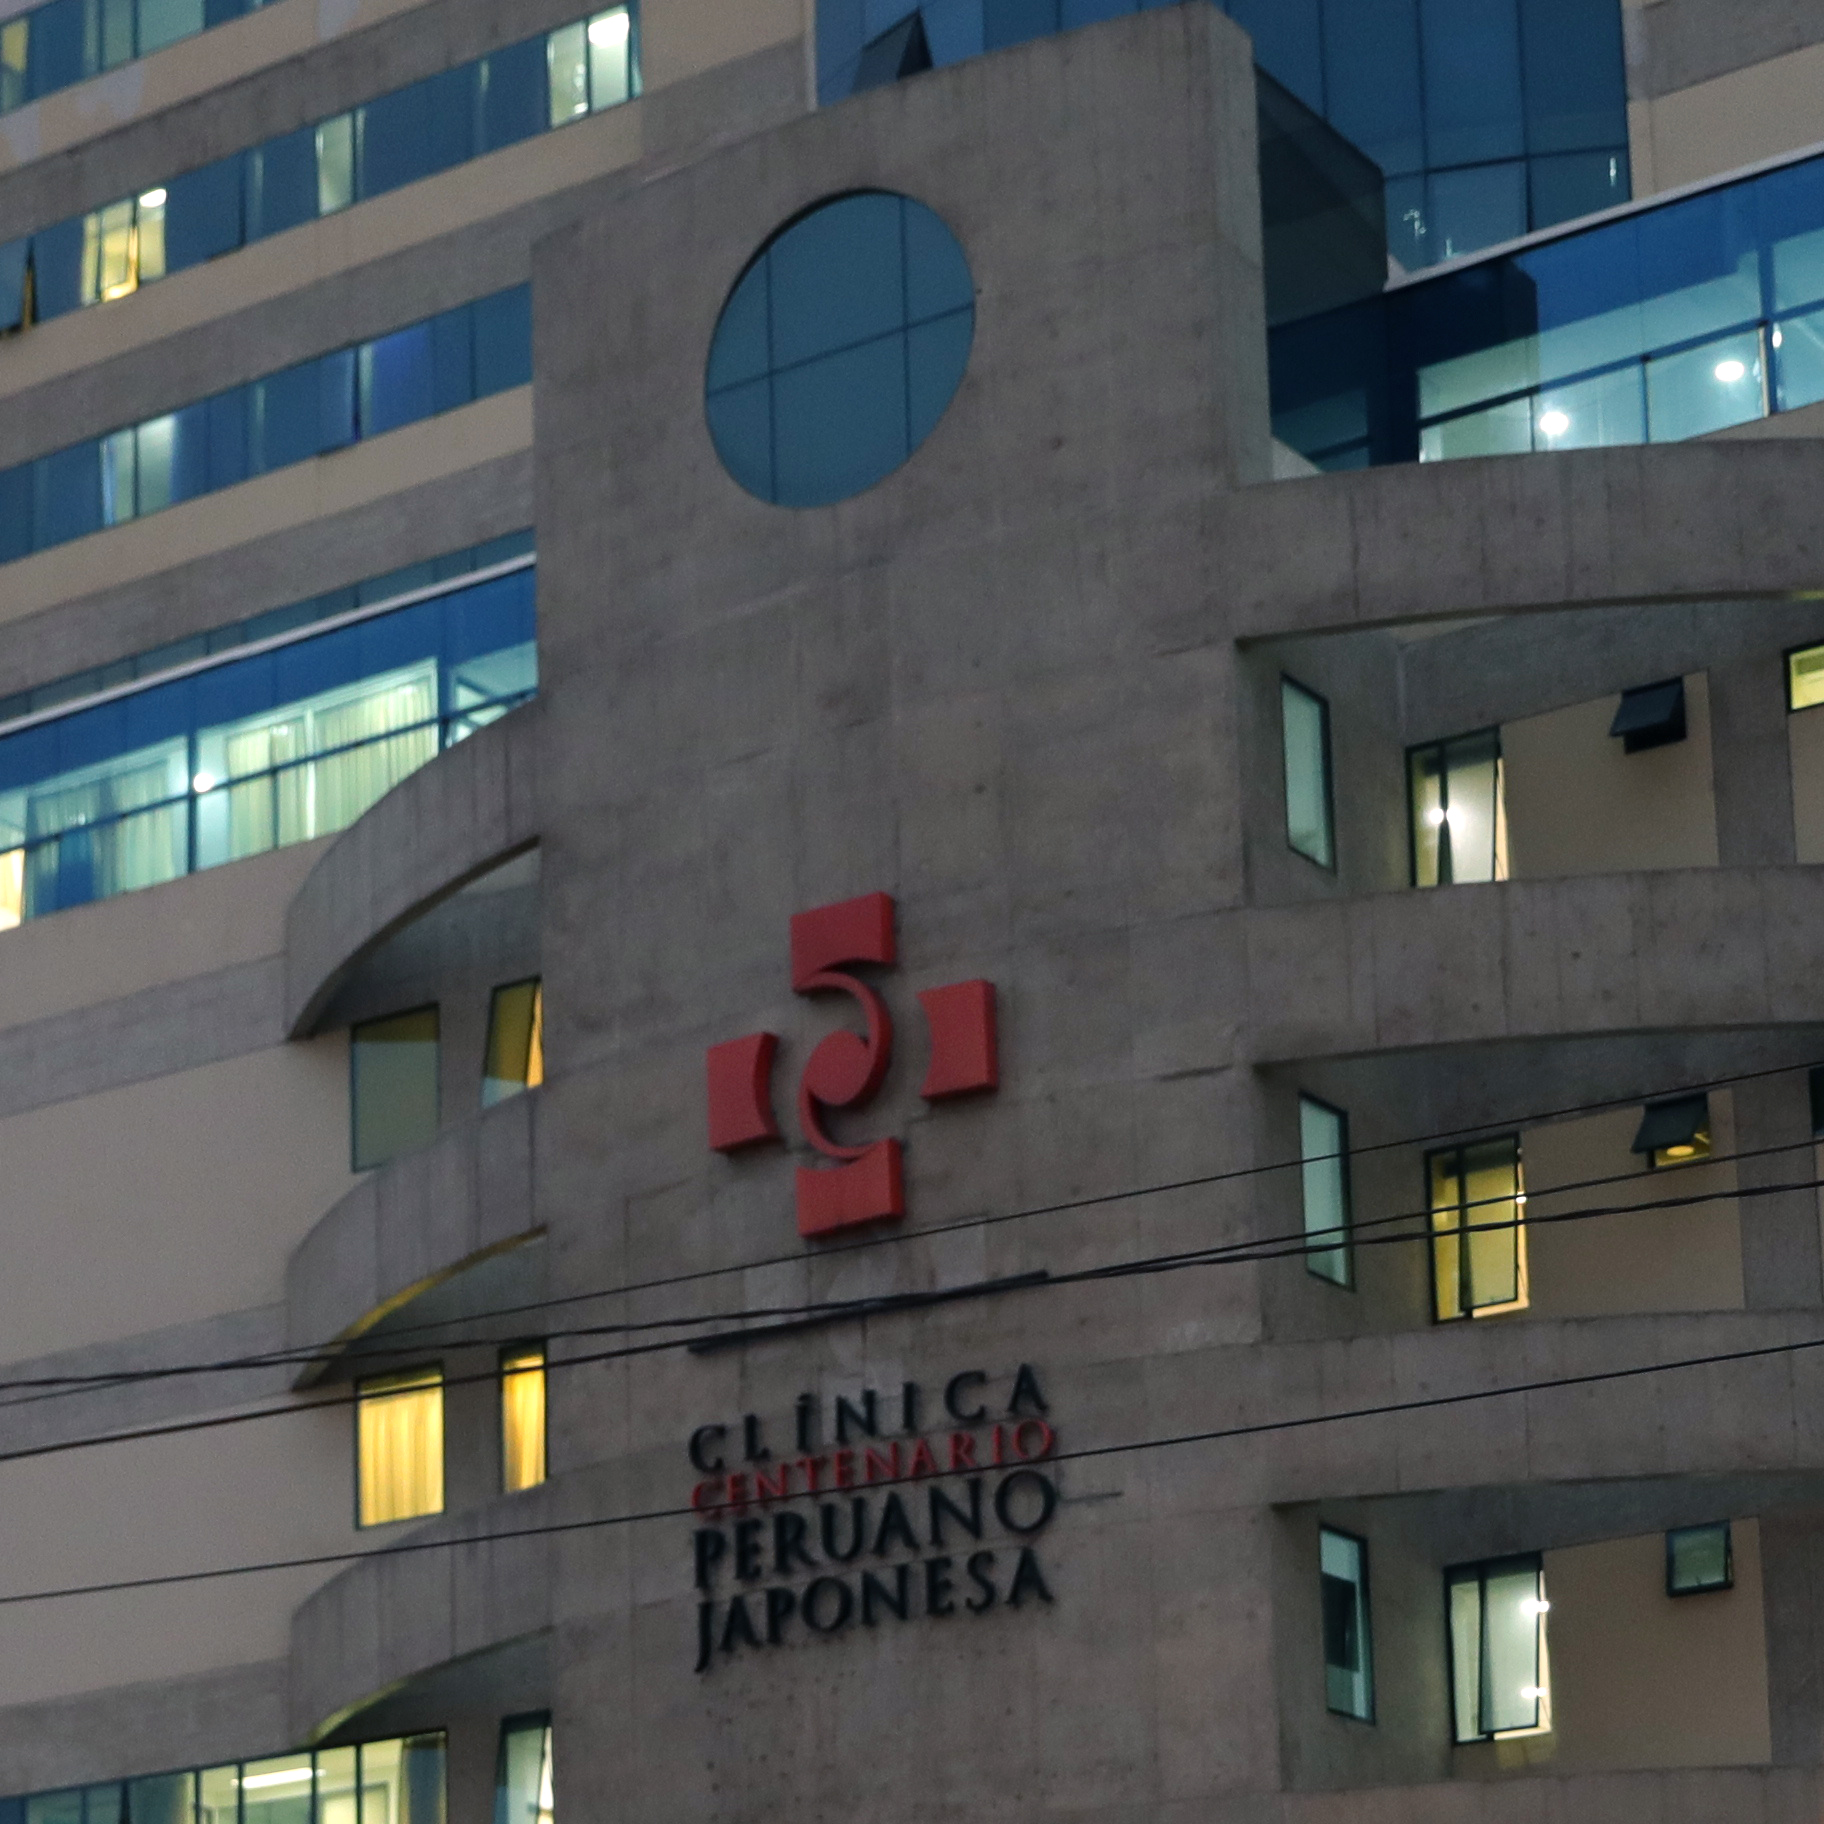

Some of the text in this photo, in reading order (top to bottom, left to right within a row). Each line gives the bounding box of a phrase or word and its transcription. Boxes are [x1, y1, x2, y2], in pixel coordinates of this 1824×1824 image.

[690, 1416, 1056, 1522] CENTENARIO
[692, 1468, 1058, 1590] PERUANO
[693, 1545, 1055, 1673] JAPONESA
